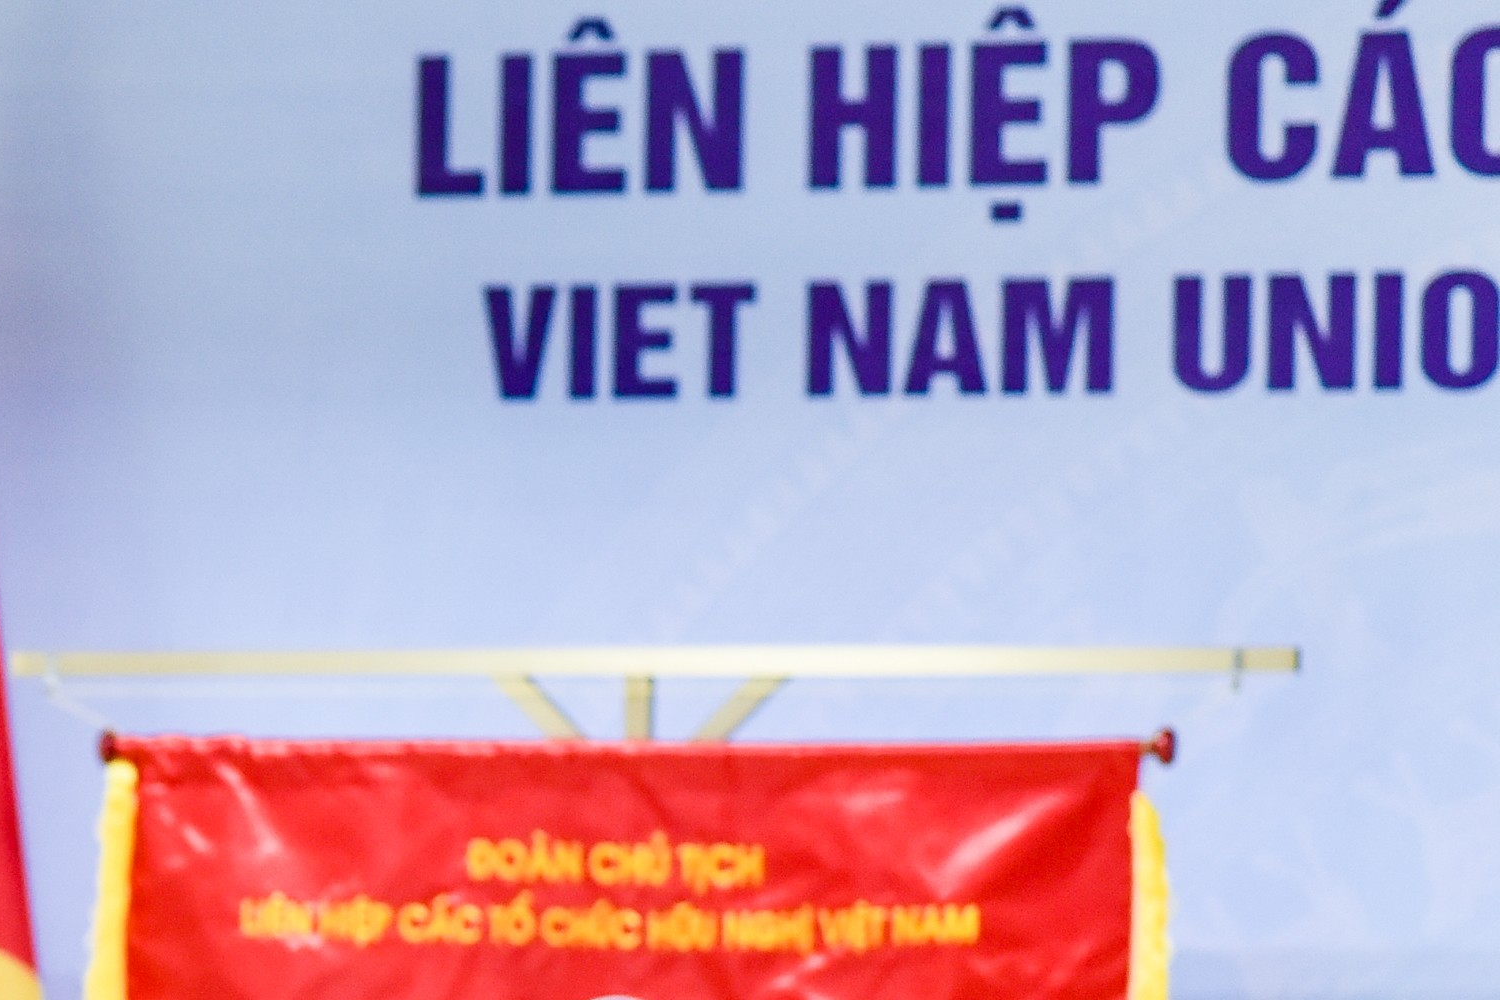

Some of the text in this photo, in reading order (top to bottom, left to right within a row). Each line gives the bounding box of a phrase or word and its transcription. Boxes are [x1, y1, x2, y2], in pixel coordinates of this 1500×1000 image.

[416, 17, 746, 195] LIÊN
[807, 6, 1162, 223] HIỆP
[483, 270, 1500, 401] VIET NAM UNIO
[678, 842, 765, 896] TỊCH
[398, 893, 483, 946] CÁC
[816, 899, 887, 953] VIỆT
[891, 903, 980, 946] NAM
